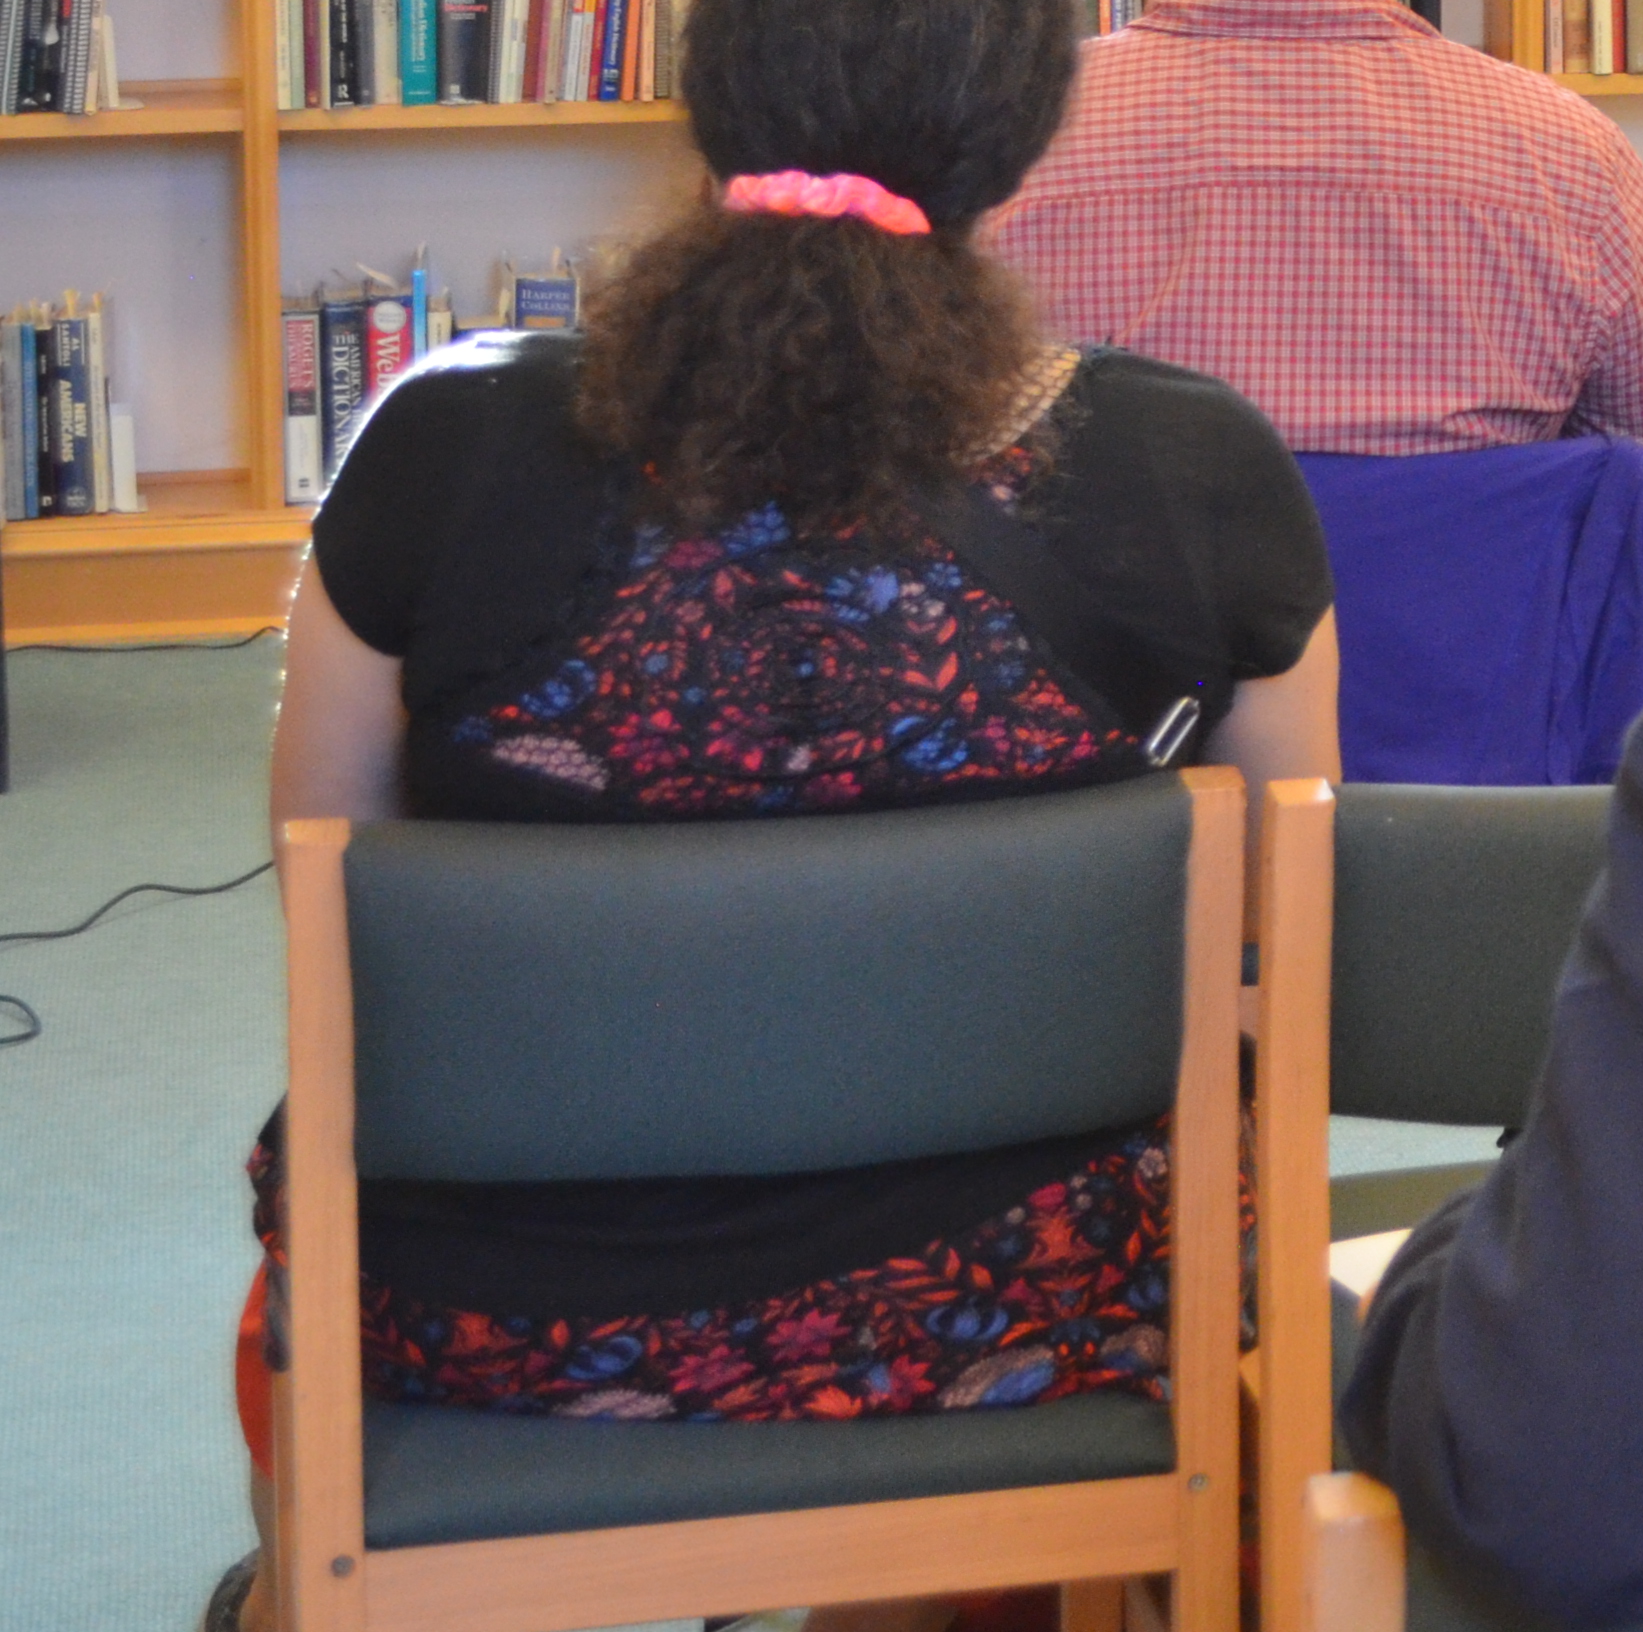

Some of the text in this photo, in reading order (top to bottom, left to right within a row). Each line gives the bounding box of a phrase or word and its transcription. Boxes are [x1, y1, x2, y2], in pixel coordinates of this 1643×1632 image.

[61, 324, 70, 366] SANTOLI
[302, 323, 315, 389] ROGET'S
[350, 345, 361, 405] AMERICAN
[60, 379, 74, 463] AMERICANS
[75, 403, 86, 437] NEW
